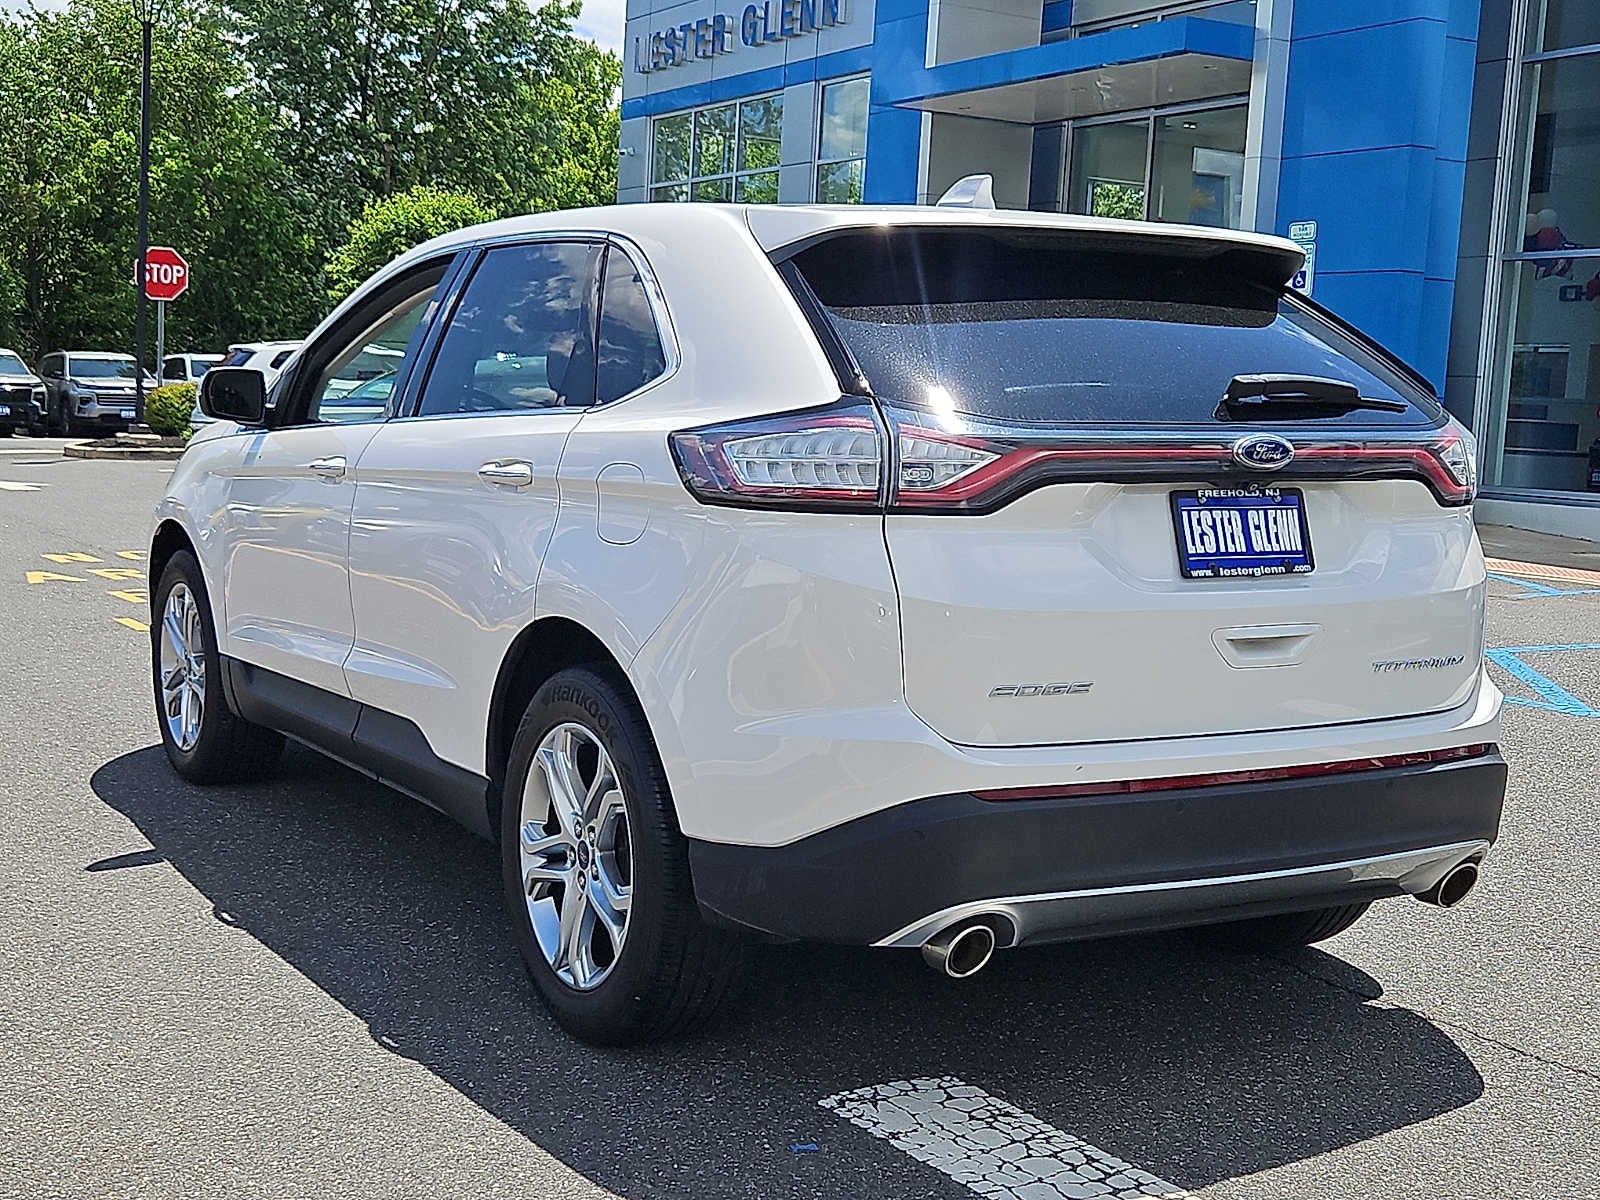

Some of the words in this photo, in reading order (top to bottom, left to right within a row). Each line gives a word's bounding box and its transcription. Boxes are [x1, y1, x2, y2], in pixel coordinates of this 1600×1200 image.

[634, 13, 733, 74] LESTER
[741, 0, 848, 47] GLENN
[1253, 443, 1288, 459] Ford
[1265, 488, 1280, 497] NJ
[1182, 510, 1247, 554] LESTER
[1247, 508, 1303, 553] GLENN
[987, 680, 1095, 698] EDGE
